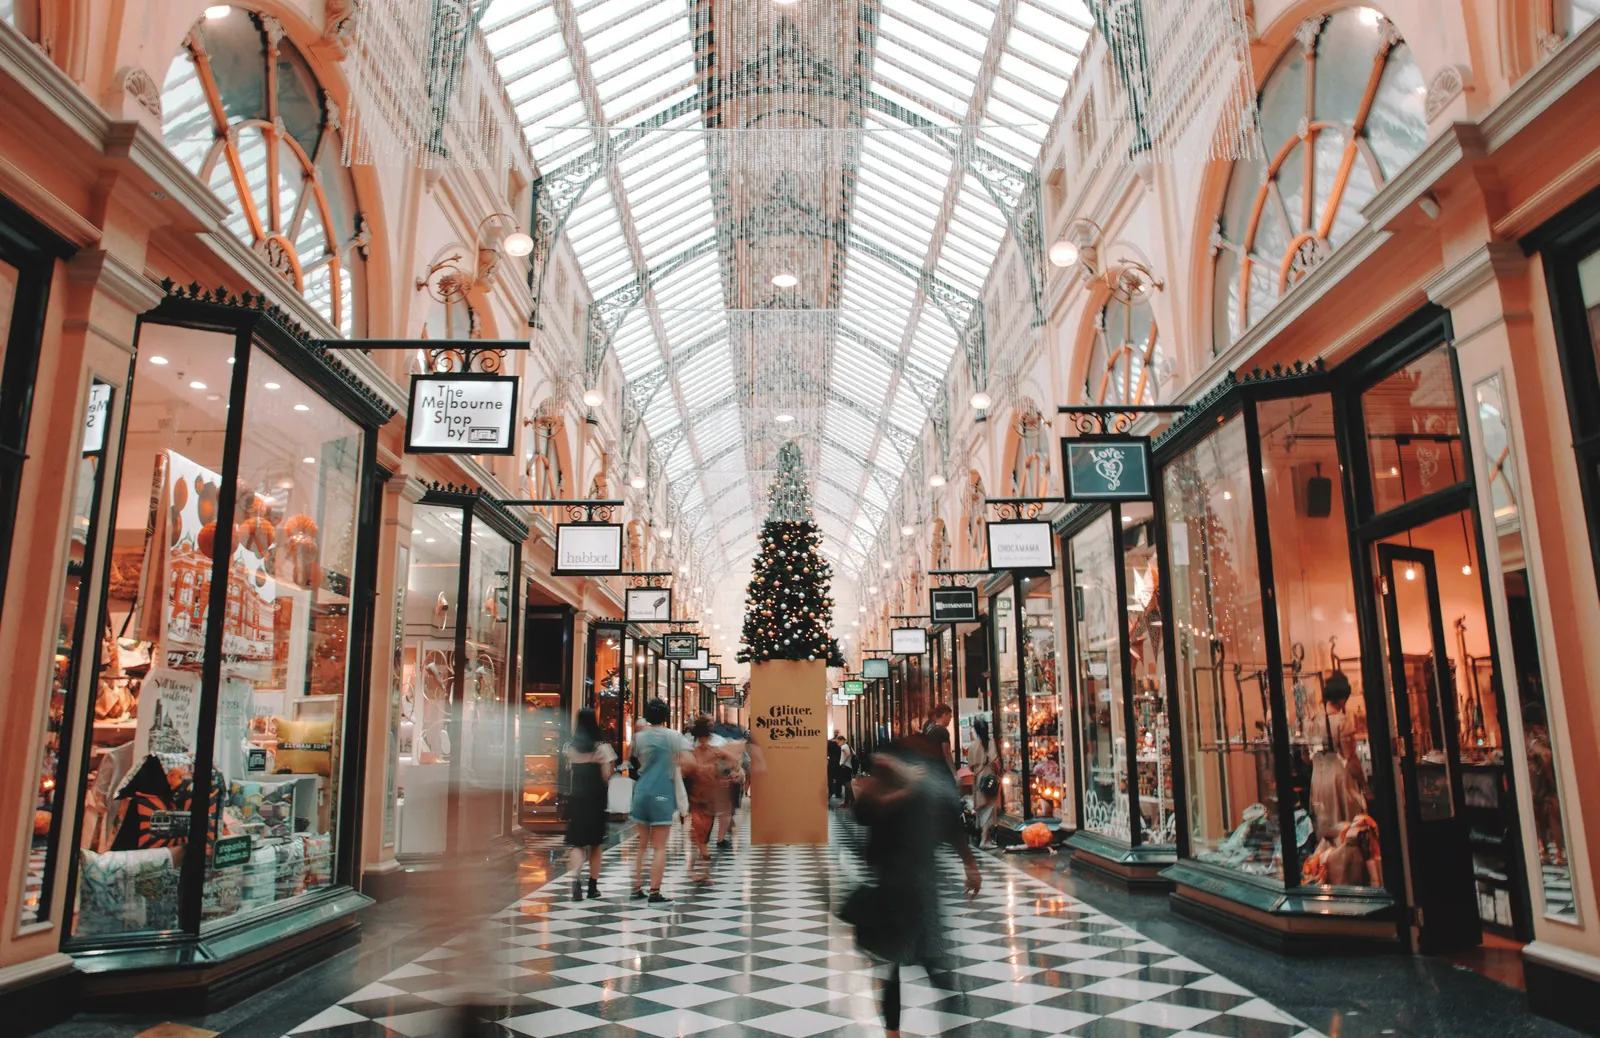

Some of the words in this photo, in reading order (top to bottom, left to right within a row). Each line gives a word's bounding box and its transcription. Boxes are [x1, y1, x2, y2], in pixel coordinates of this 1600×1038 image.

[438, 385, 463, 400] The
[422, 396, 502, 409] Melbourne
[434, 411, 472, 427] Shop
[447, 423, 465, 440] by
[998, 544, 1040, 553] CHOCAMAMA
[566, 552, 612, 564] habbot.
[756, 716, 803, 728] Sparkle
